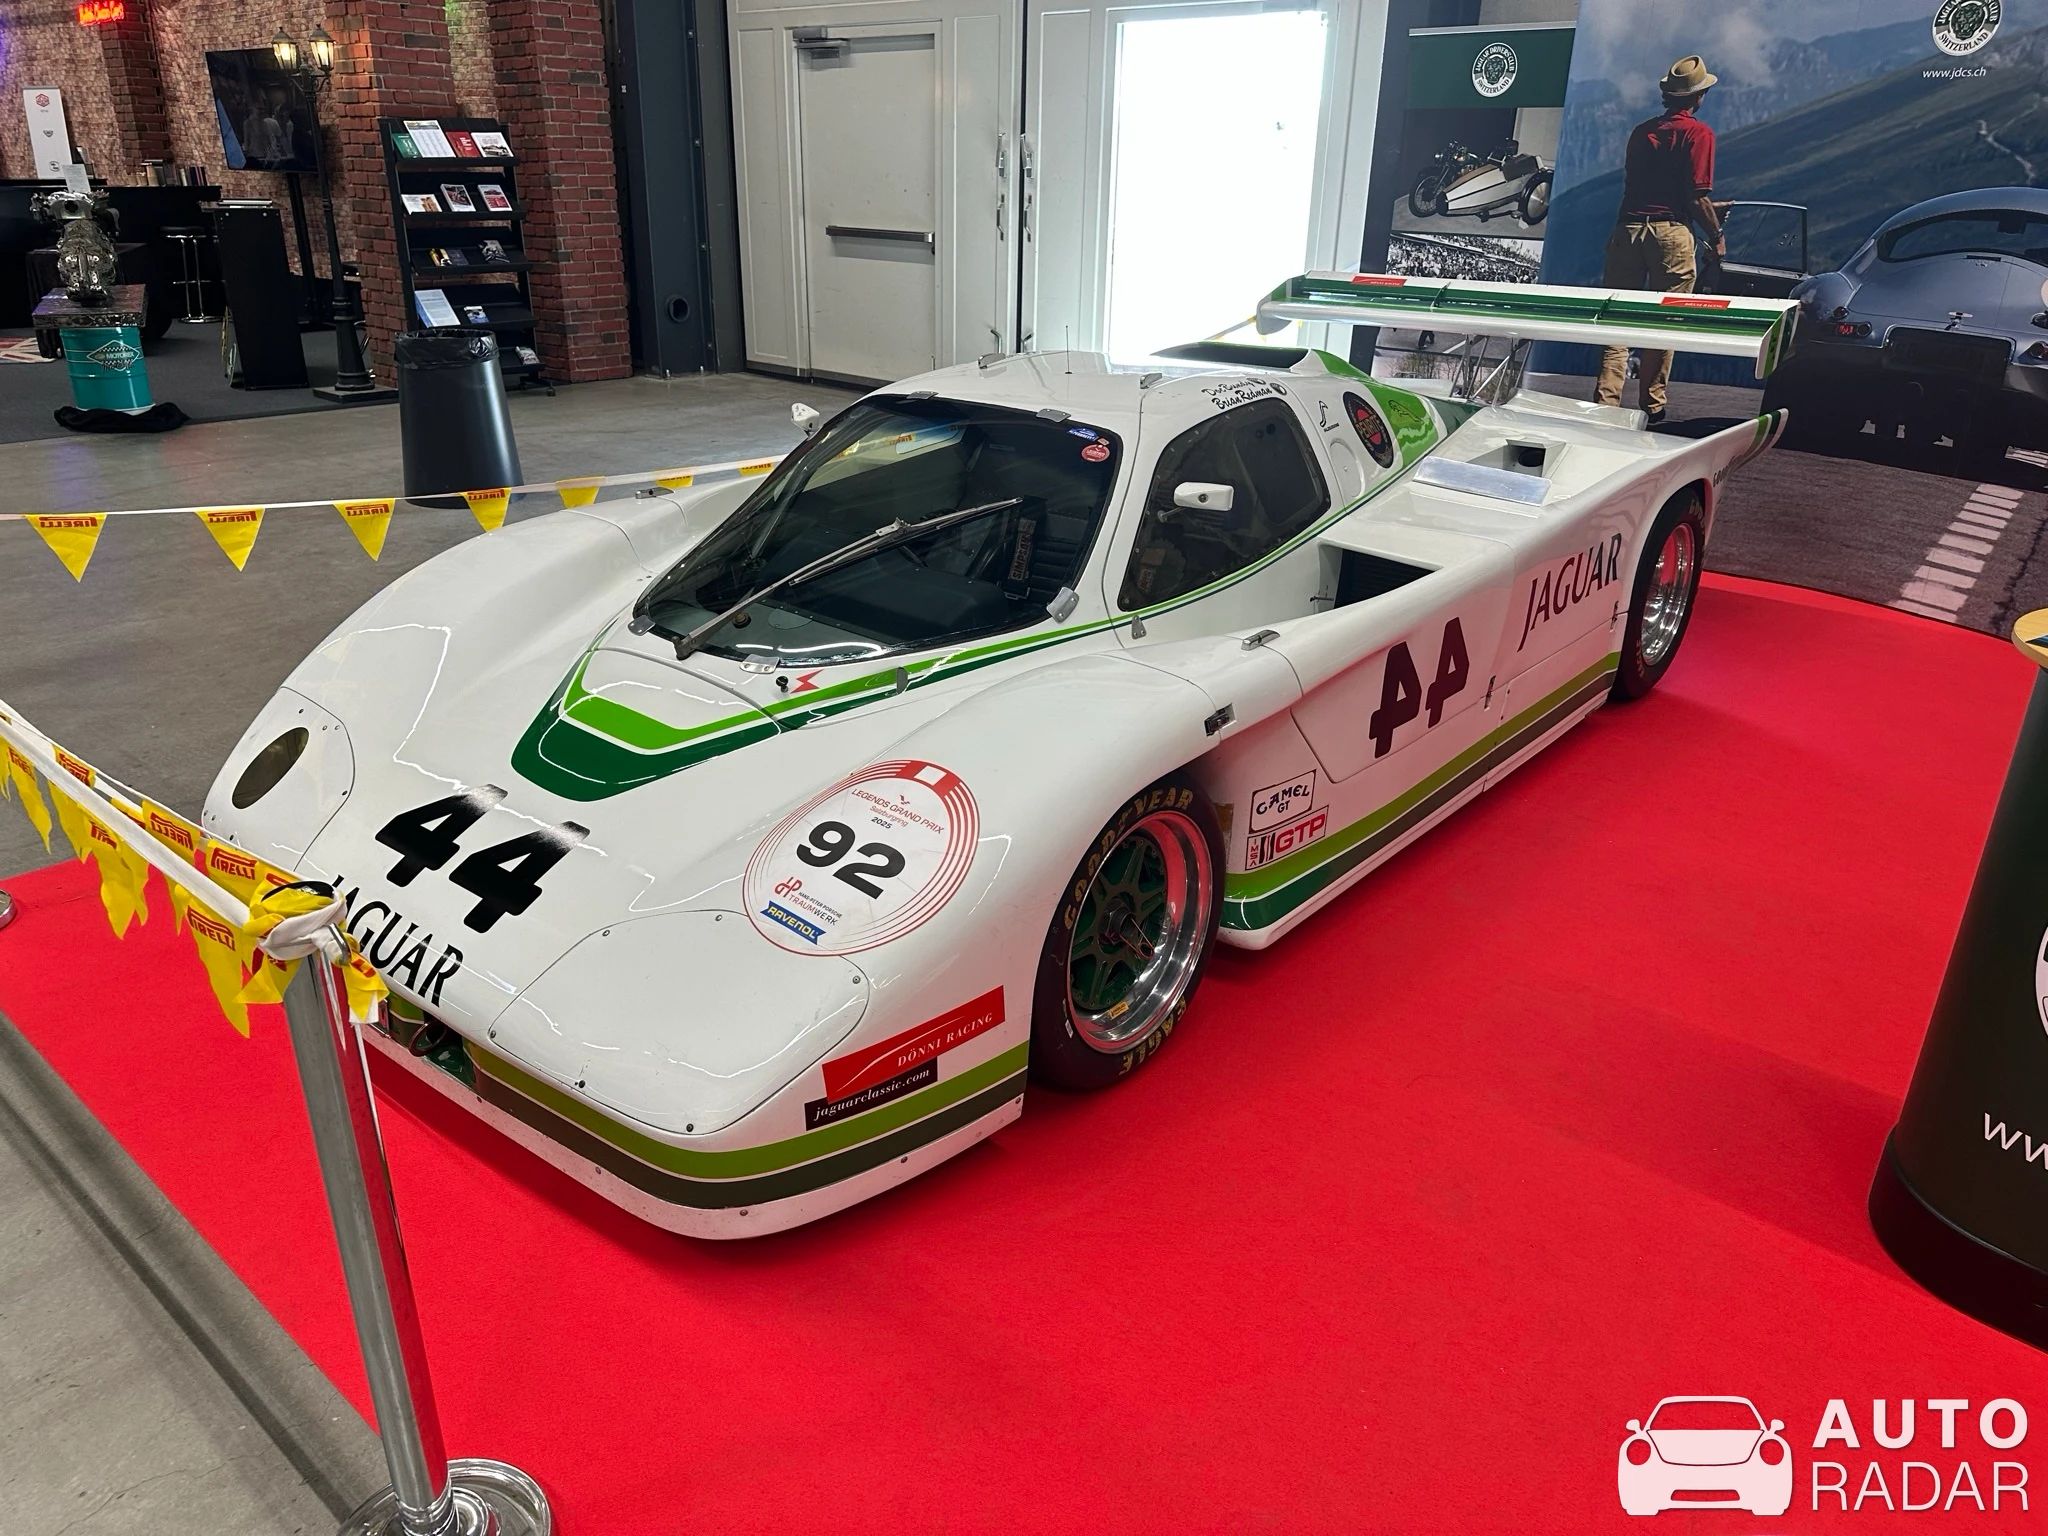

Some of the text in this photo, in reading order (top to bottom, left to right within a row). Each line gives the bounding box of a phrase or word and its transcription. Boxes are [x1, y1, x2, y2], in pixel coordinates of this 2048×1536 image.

[1938, 31, 1989, 52] SWITZERLAND
[1477, 79, 1510, 94] SWITZERLAND
[1922, 66, 1987, 80] www.jdcs.ch
[105, 351, 134, 359] MOTOREX
[1211, 387, 1273, 410] Brian Redman
[1011, 533, 1032, 582] SIMPSON
[1516, 532, 1622, 653] JAGUAR
[1369, 616, 1470, 759] 44
[851, 788, 944, 835] LEGENDS GRAND PRIX
[1256, 784, 1310, 815] CAMEL
[1277, 800, 1290, 813] GT
[869, 805, 909, 828] Salzburgring
[871, 816, 893, 829] 2025
[1275, 813, 1326, 854] GTP
[210, 847, 259, 880] PIRELLI
[375, 783, 591, 934] 44
[796, 820, 906, 900] 92
[767, 906, 817, 940] RAVENOL
[788, 894, 839, 926] TRAUMWERK
[822, 904, 843, 919] PORSCHE
[187, 904, 236, 951] PIRELLI
[897, 1012, 994, 1068] DÖNNI RACING
[813, 1068, 931, 1122] jaguarclassic.com
